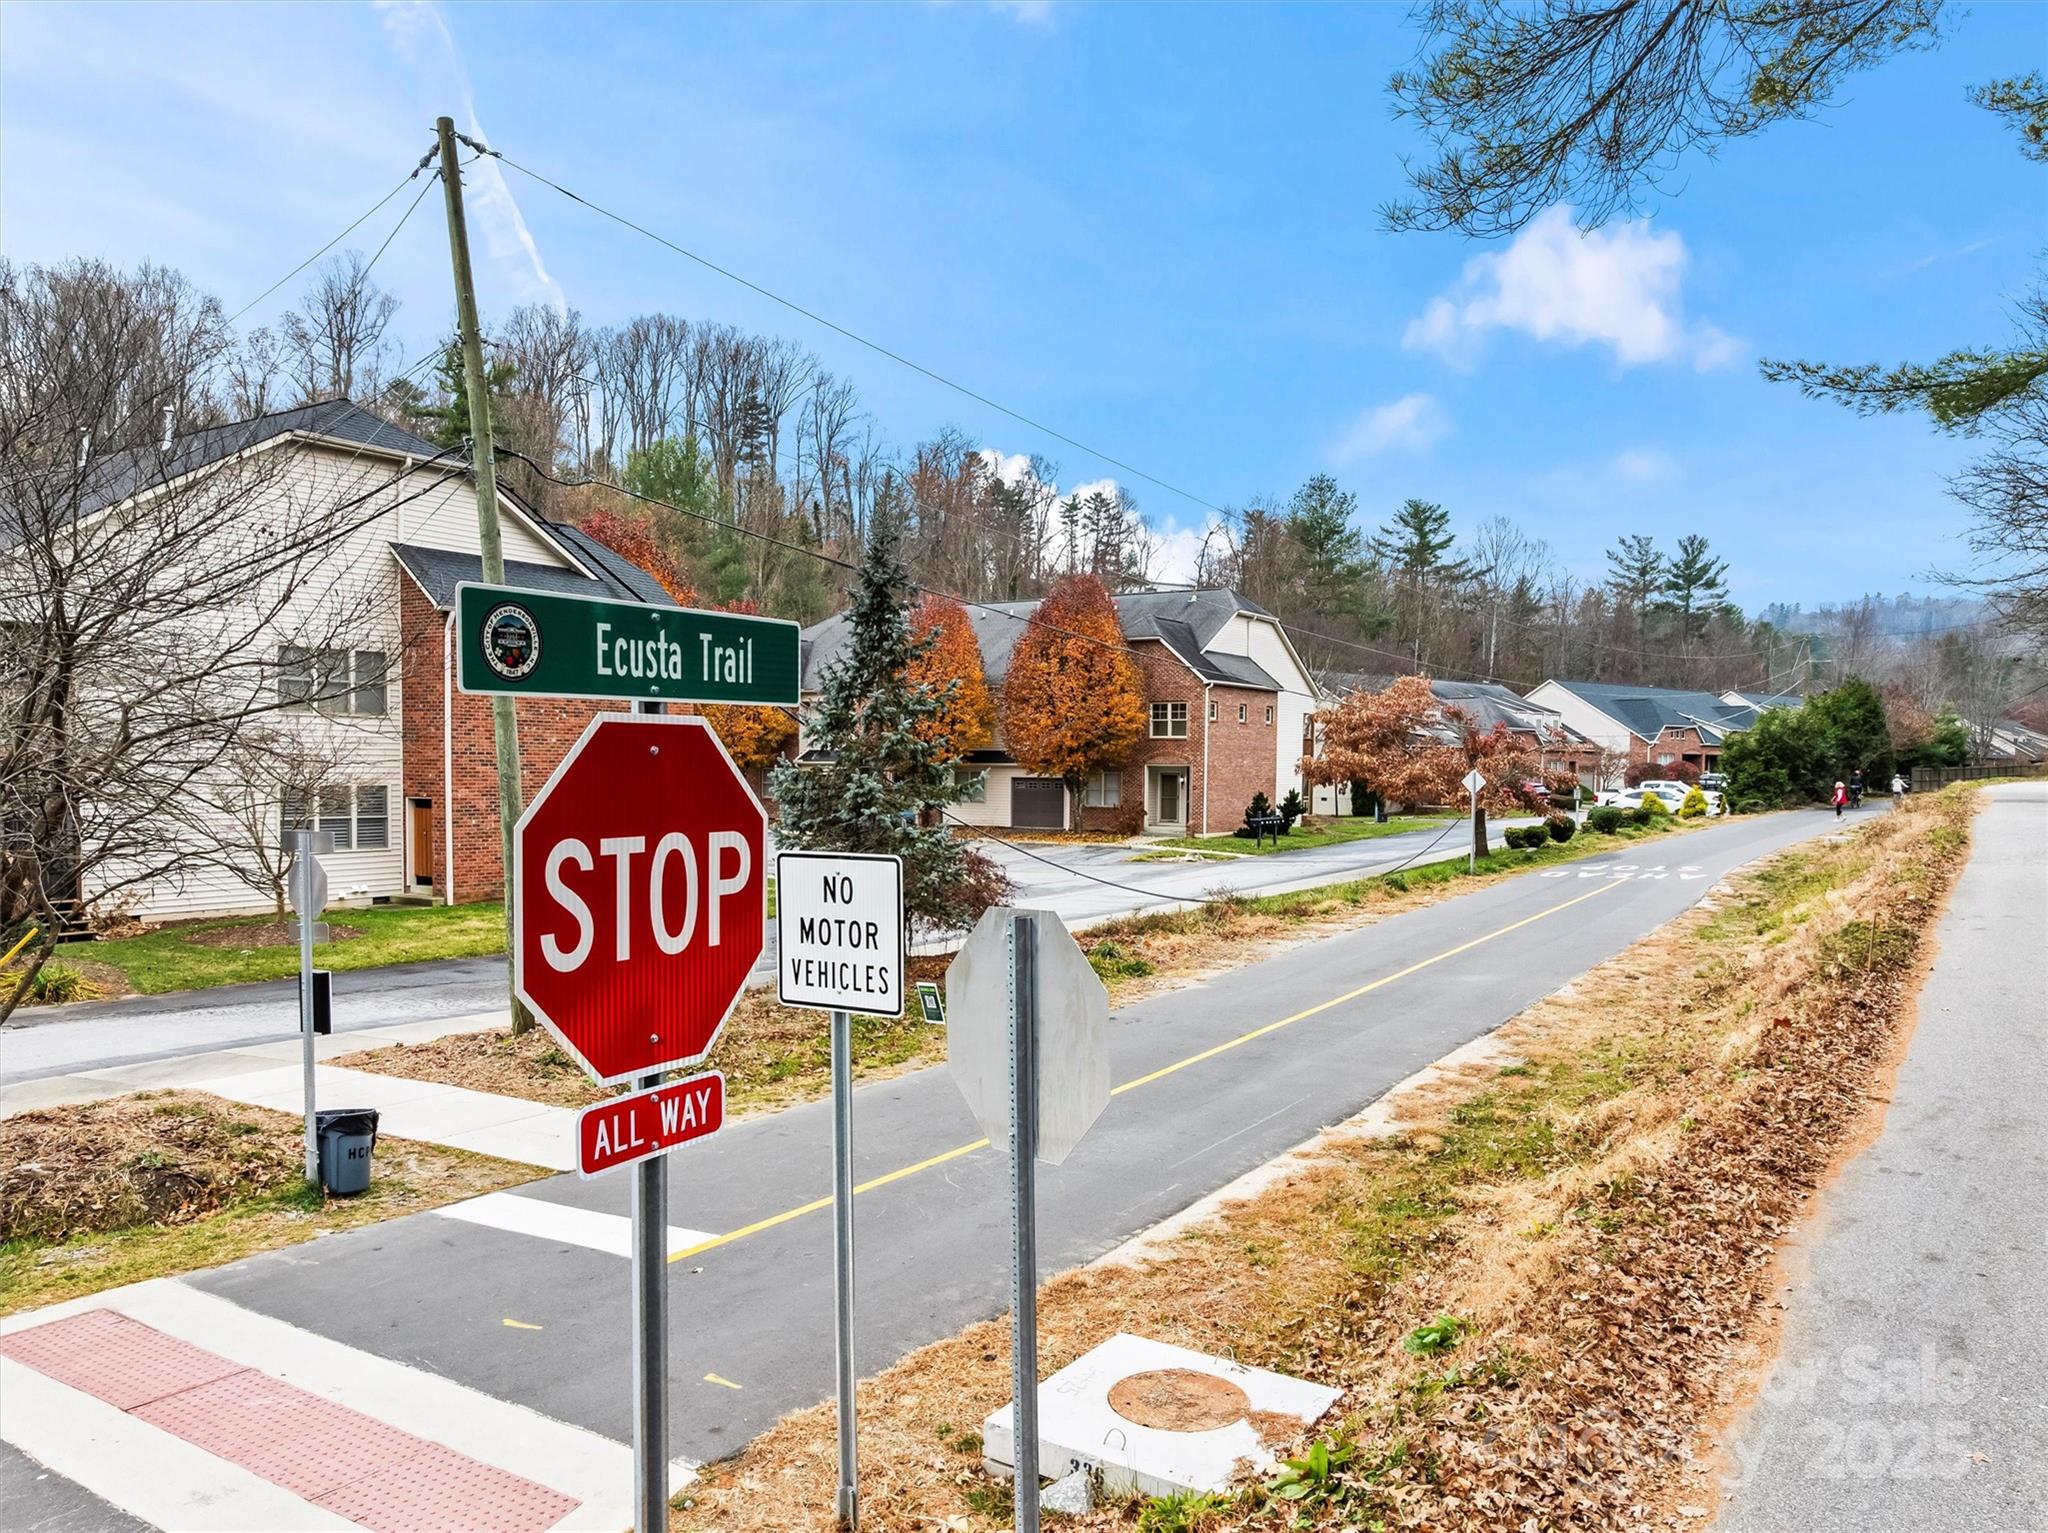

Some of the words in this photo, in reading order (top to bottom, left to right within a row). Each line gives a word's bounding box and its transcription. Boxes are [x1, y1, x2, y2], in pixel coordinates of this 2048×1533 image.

[596, 622, 682, 680] Ecusta
[700, 632, 753, 684] Trail
[540, 830, 752, 974] STOP
[823, 875, 854, 905] NO
[800, 916, 879, 950] MOTOR
[791, 958, 889, 996] VEHICLES
[594, 1109, 644, 1161] ALL
[660, 1087, 712, 1137] WAY
